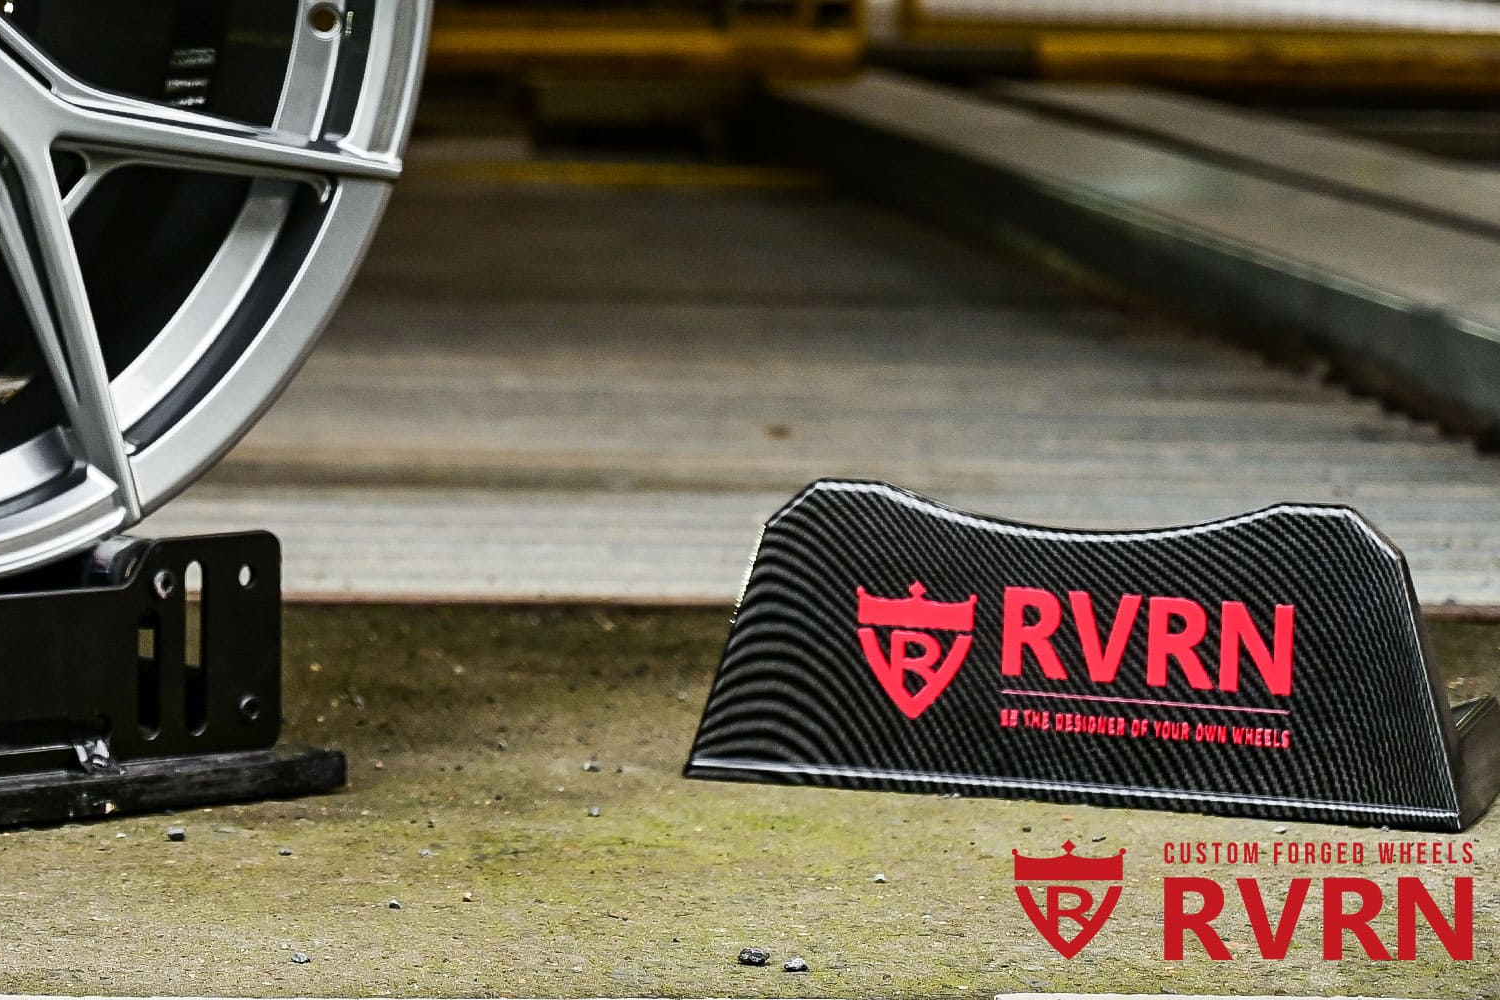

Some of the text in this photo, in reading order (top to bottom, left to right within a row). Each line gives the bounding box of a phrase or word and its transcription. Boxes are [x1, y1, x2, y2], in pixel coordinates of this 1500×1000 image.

[1001, 586, 1295, 697] RVRN
[1000, 708, 1291, 749] BE THE DESIGNER OF YOUR OWN WHEELS
